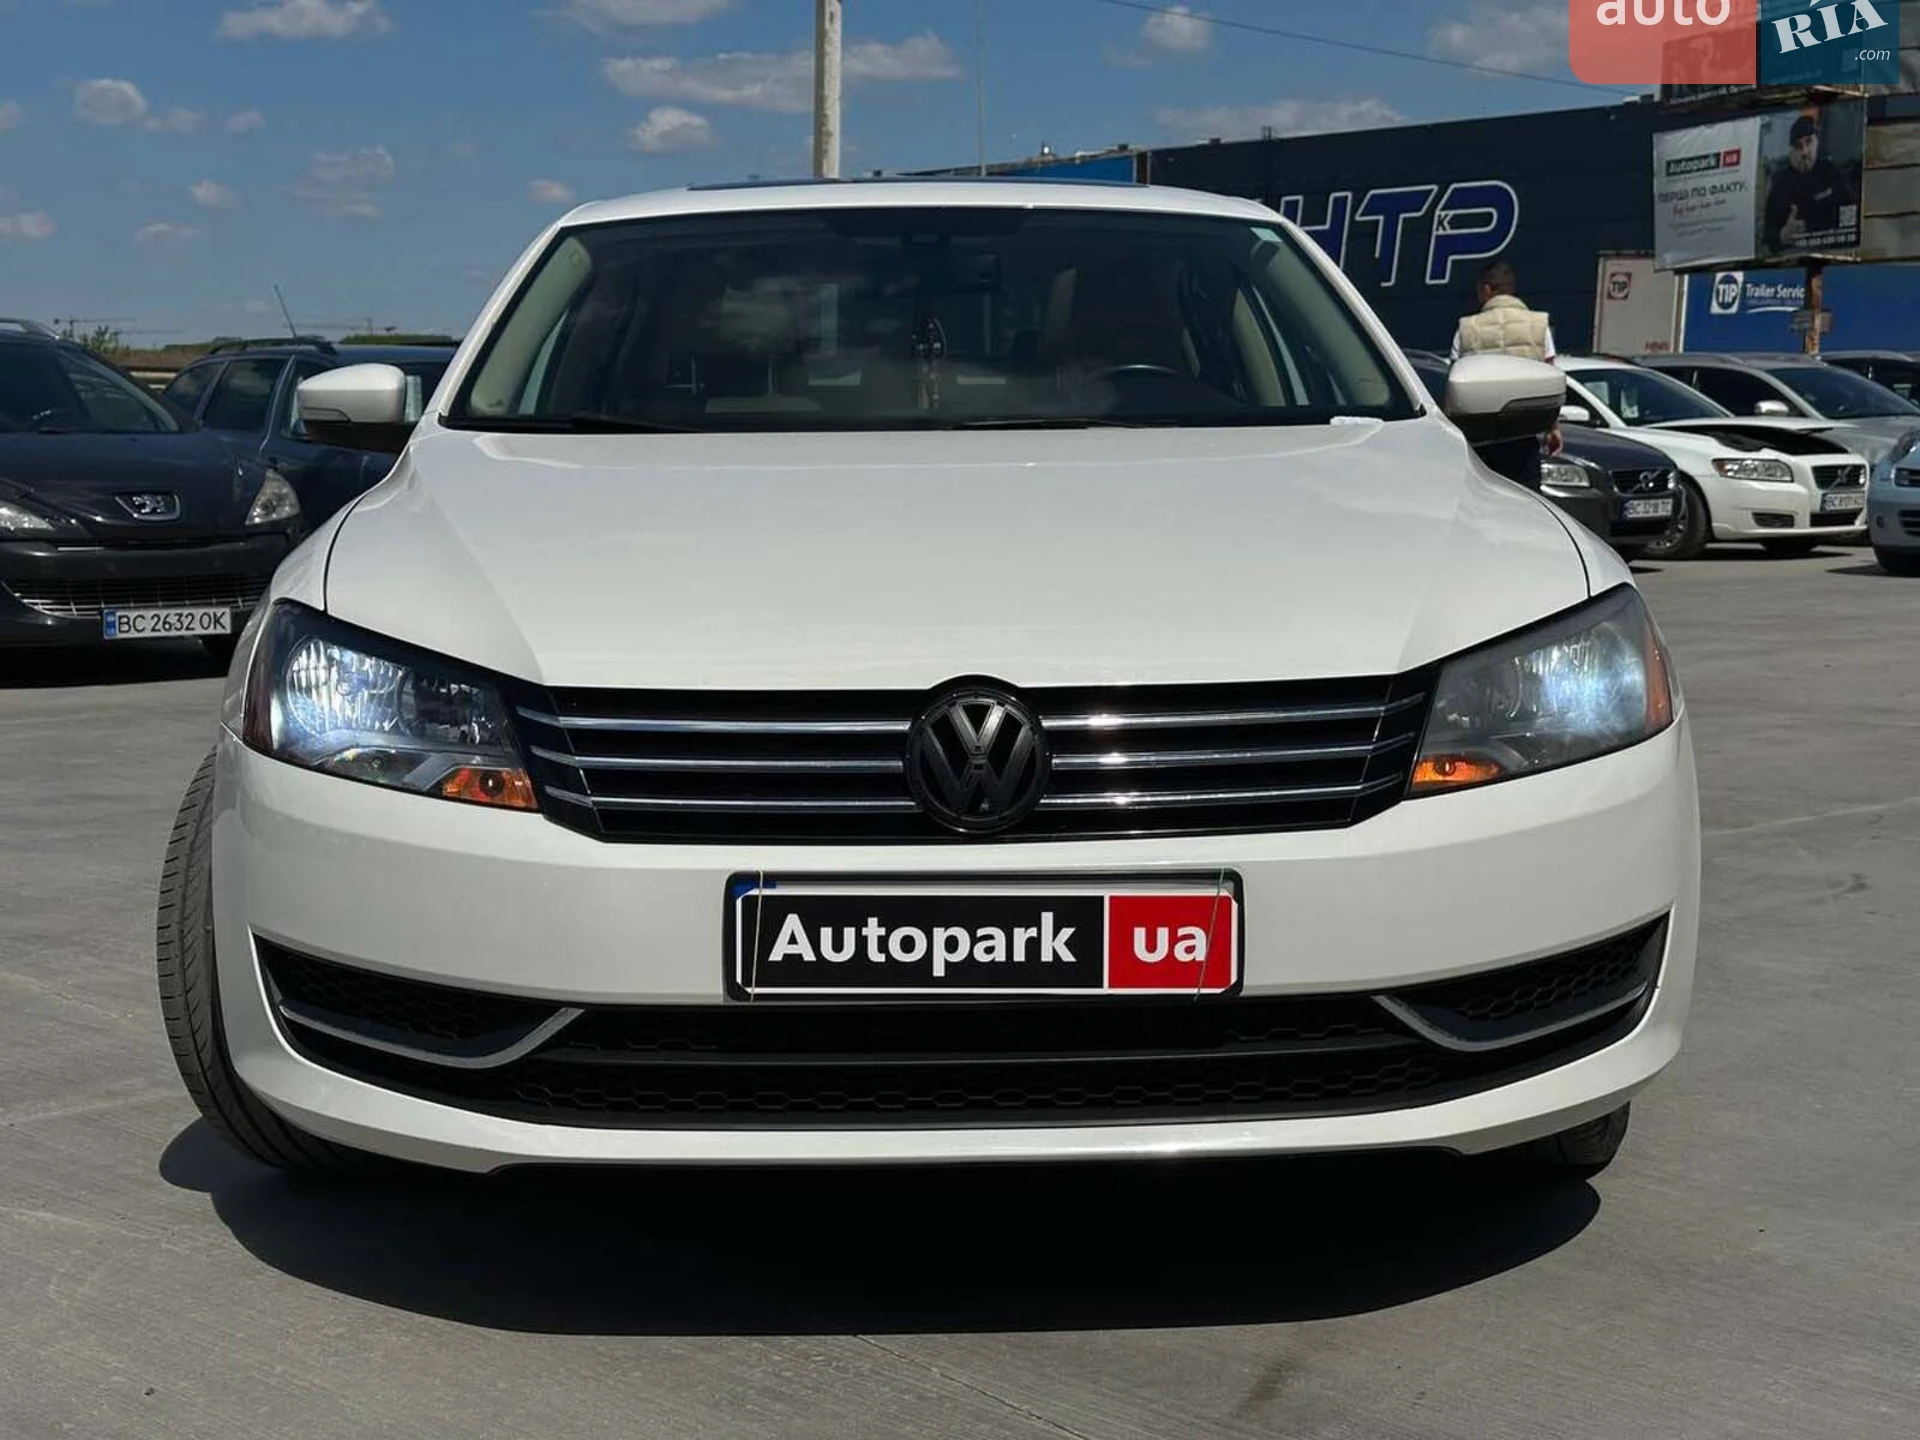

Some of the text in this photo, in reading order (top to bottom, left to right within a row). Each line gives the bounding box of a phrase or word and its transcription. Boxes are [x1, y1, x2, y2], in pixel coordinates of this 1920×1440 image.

[1717, 283, 1738, 303] TIP
[1746, 283, 1775, 297] Trailer
[118, 614, 146, 633] BC
[150, 612, 195, 632] 2632
[199, 611, 227, 631] OK
[768, 912, 1208, 976] Autopark ua
